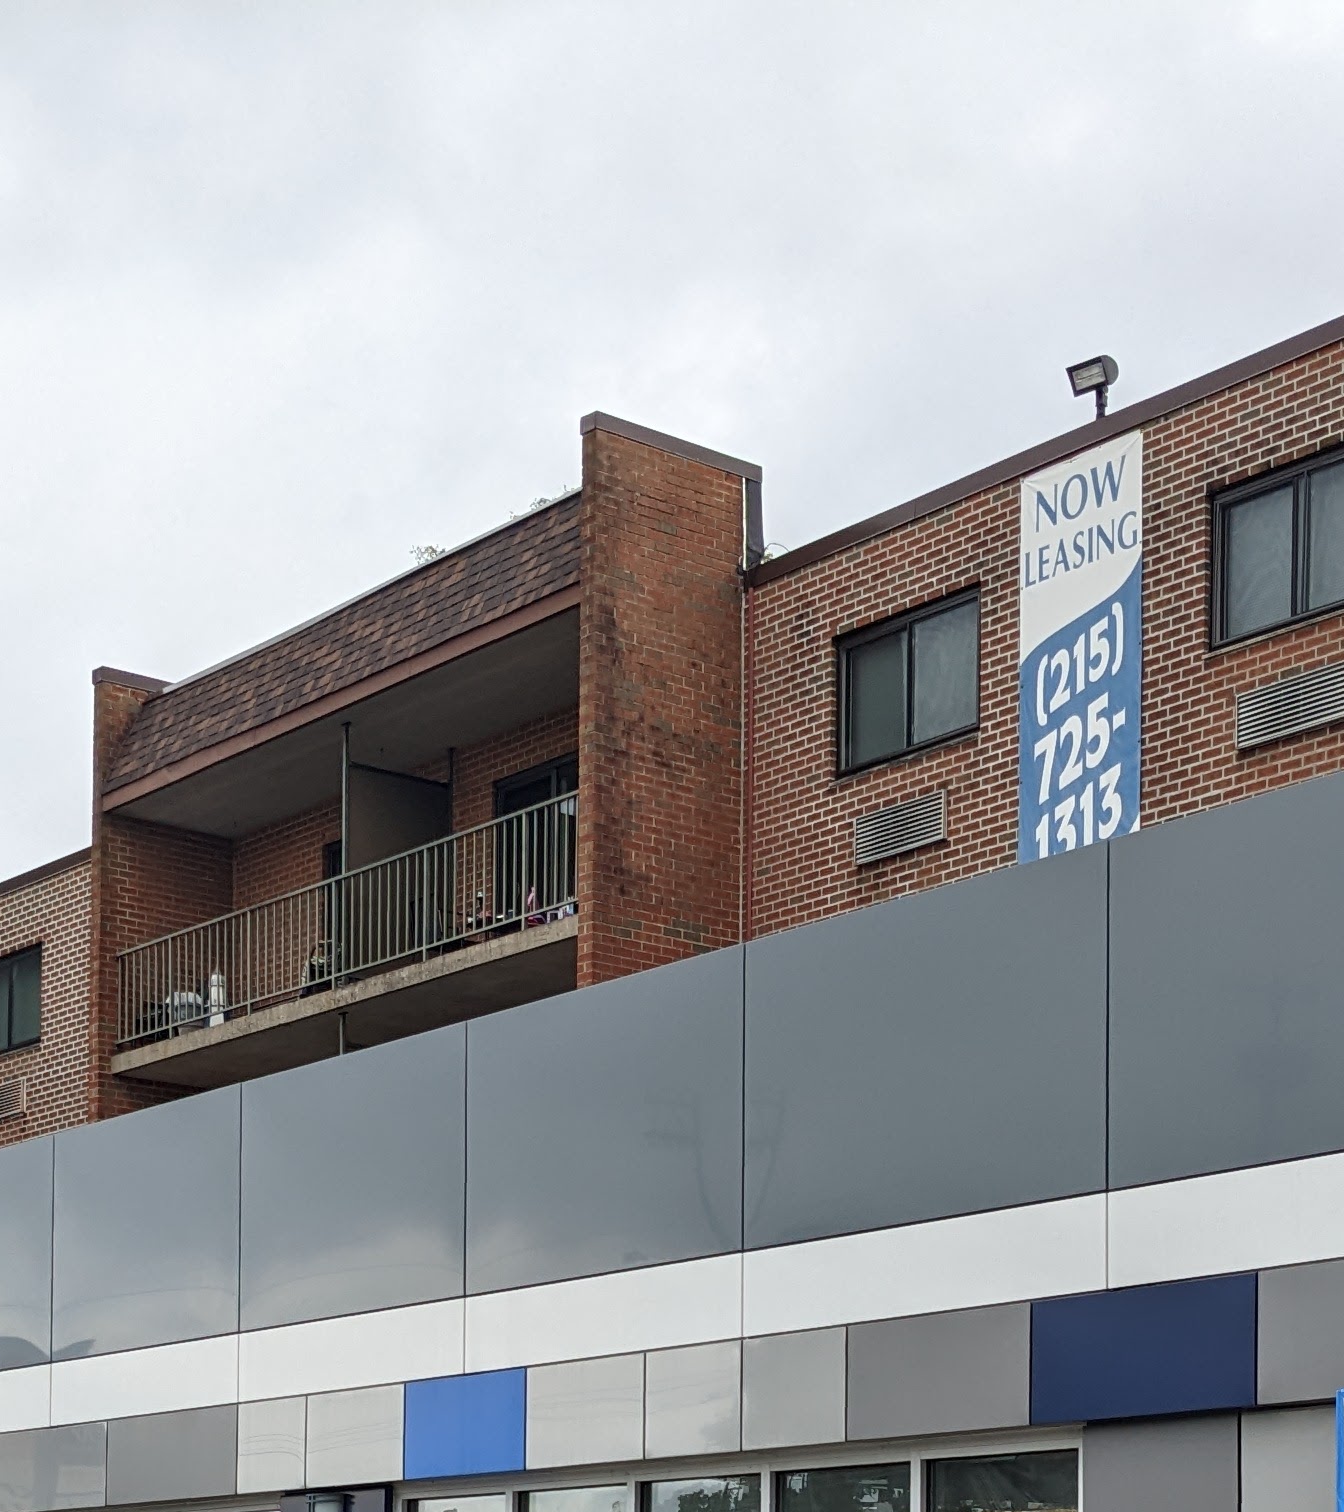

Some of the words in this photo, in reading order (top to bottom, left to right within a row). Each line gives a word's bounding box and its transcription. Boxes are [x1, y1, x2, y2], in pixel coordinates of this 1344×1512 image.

[1035, 456, 1126, 533] NOW
[1024, 511, 1138, 588] LEASING
[1036, 602, 1124, 726] (215)
[1033, 692, 1125, 803] 725-
[1036, 764, 1122, 859] 1313
